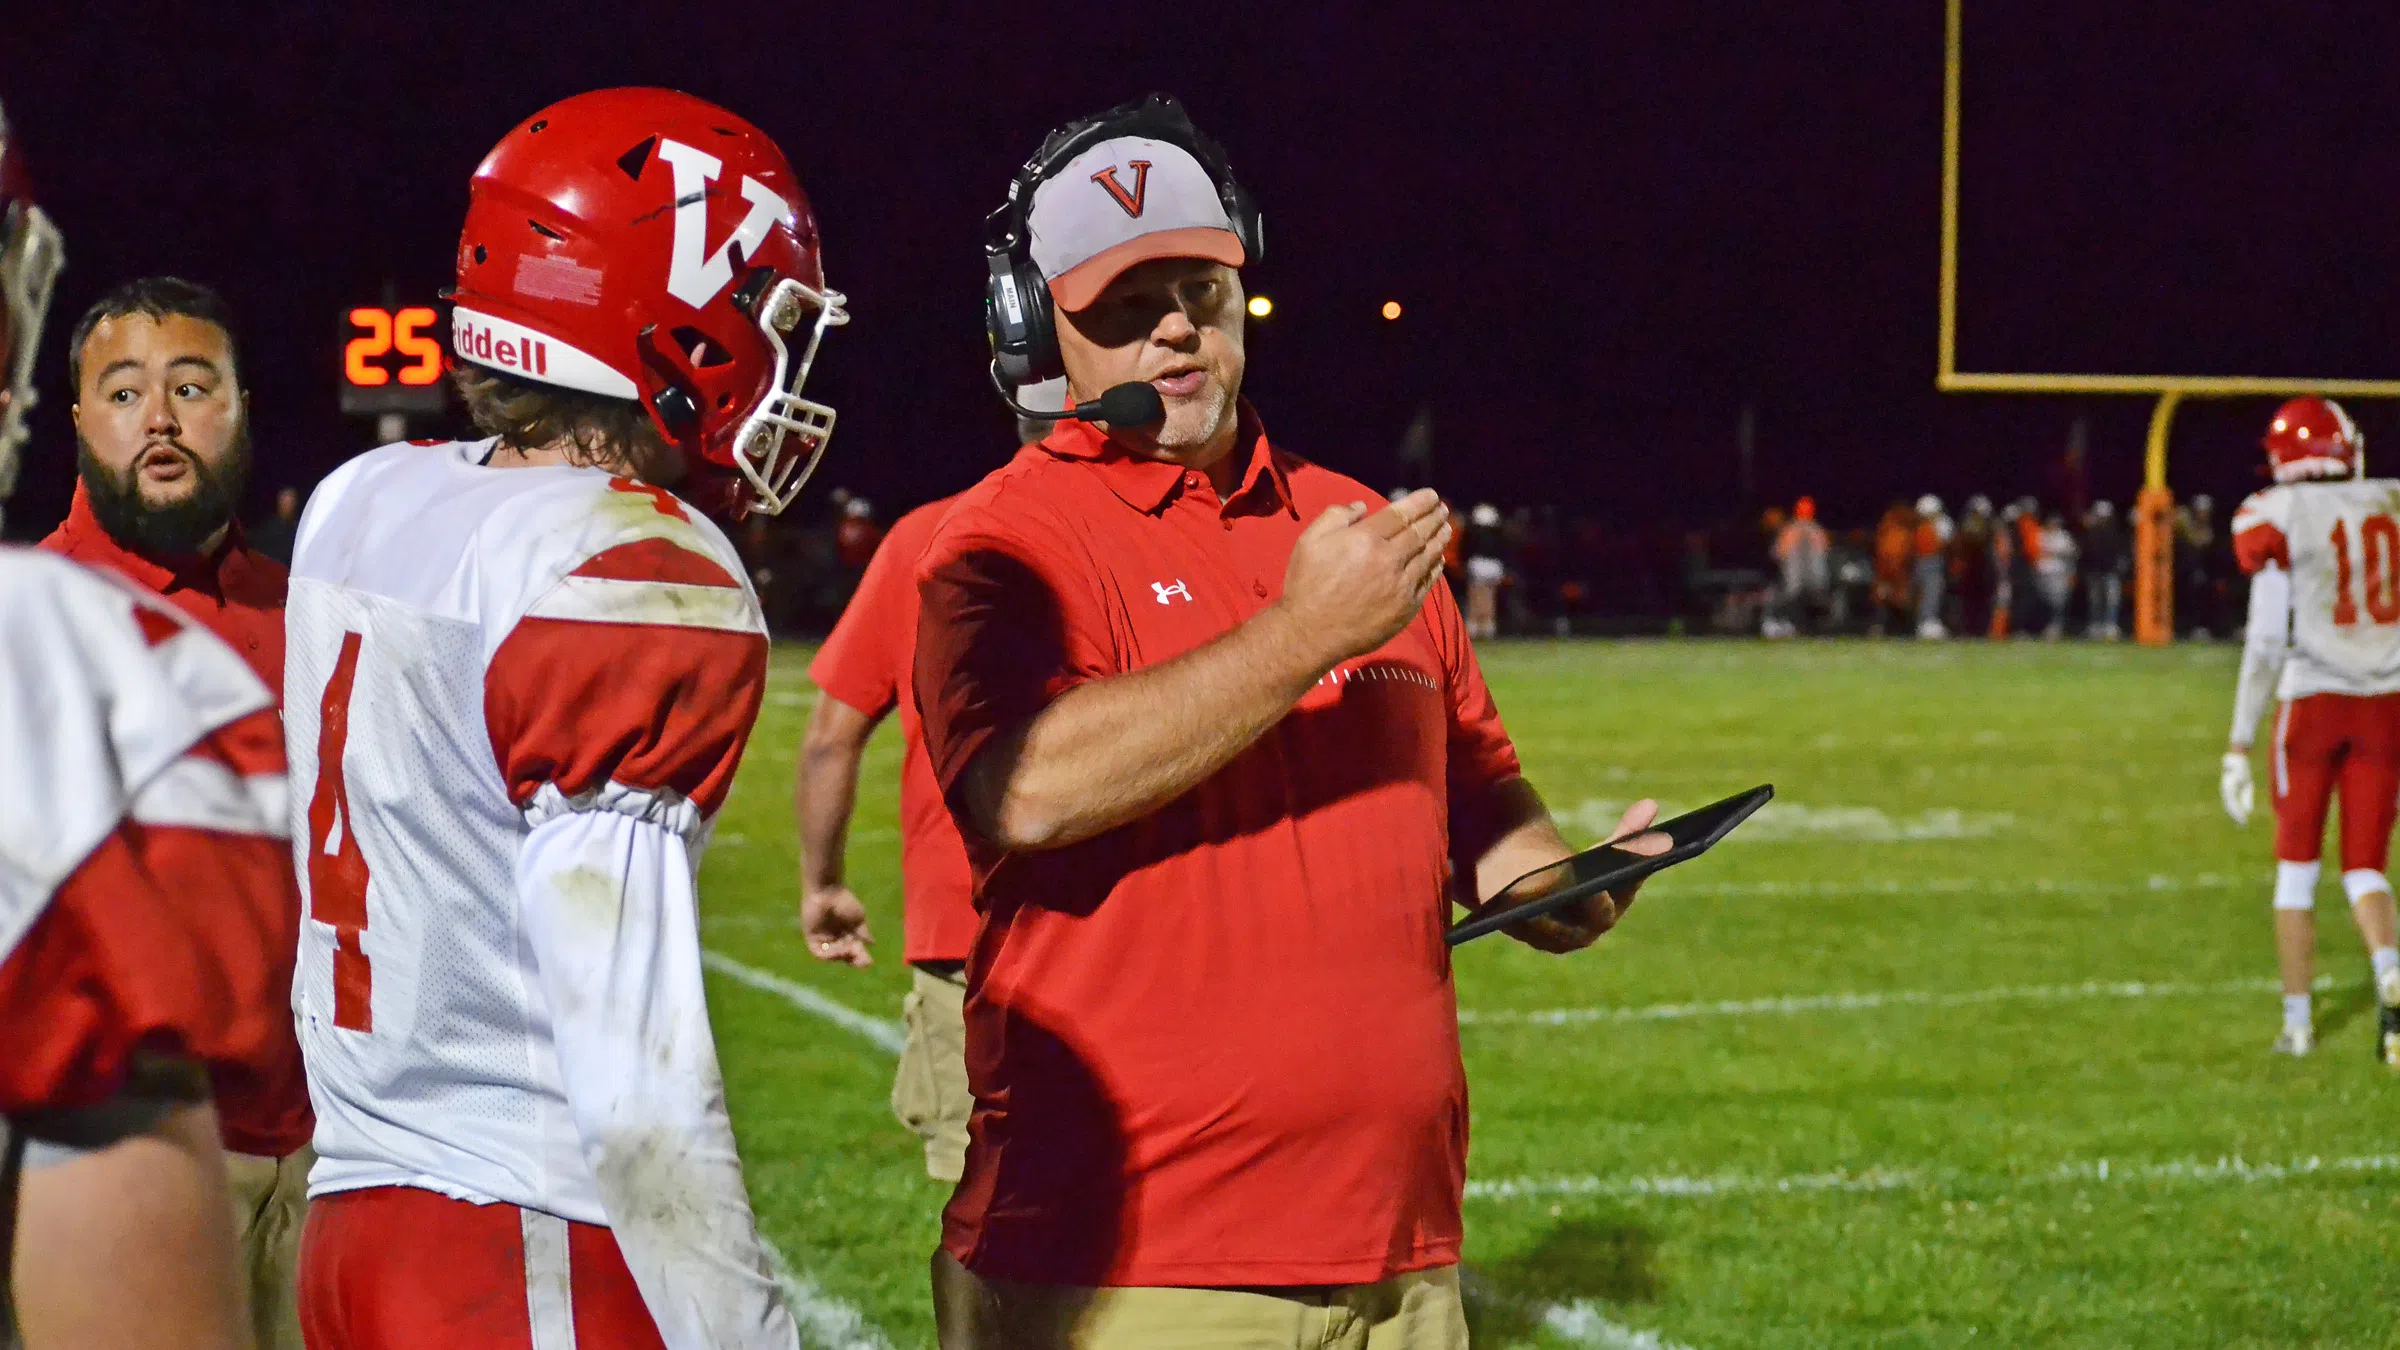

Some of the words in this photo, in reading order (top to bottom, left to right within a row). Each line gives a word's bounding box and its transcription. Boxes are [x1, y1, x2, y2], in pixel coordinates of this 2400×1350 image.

[658, 138, 792, 310] V
[1090, 160, 1153, 219] V
[1005, 287, 1017, 309] MAIN
[345, 307, 443, 386] 25
[2329, 512, 2400, 626] 10
[308, 630, 373, 1034] 4
